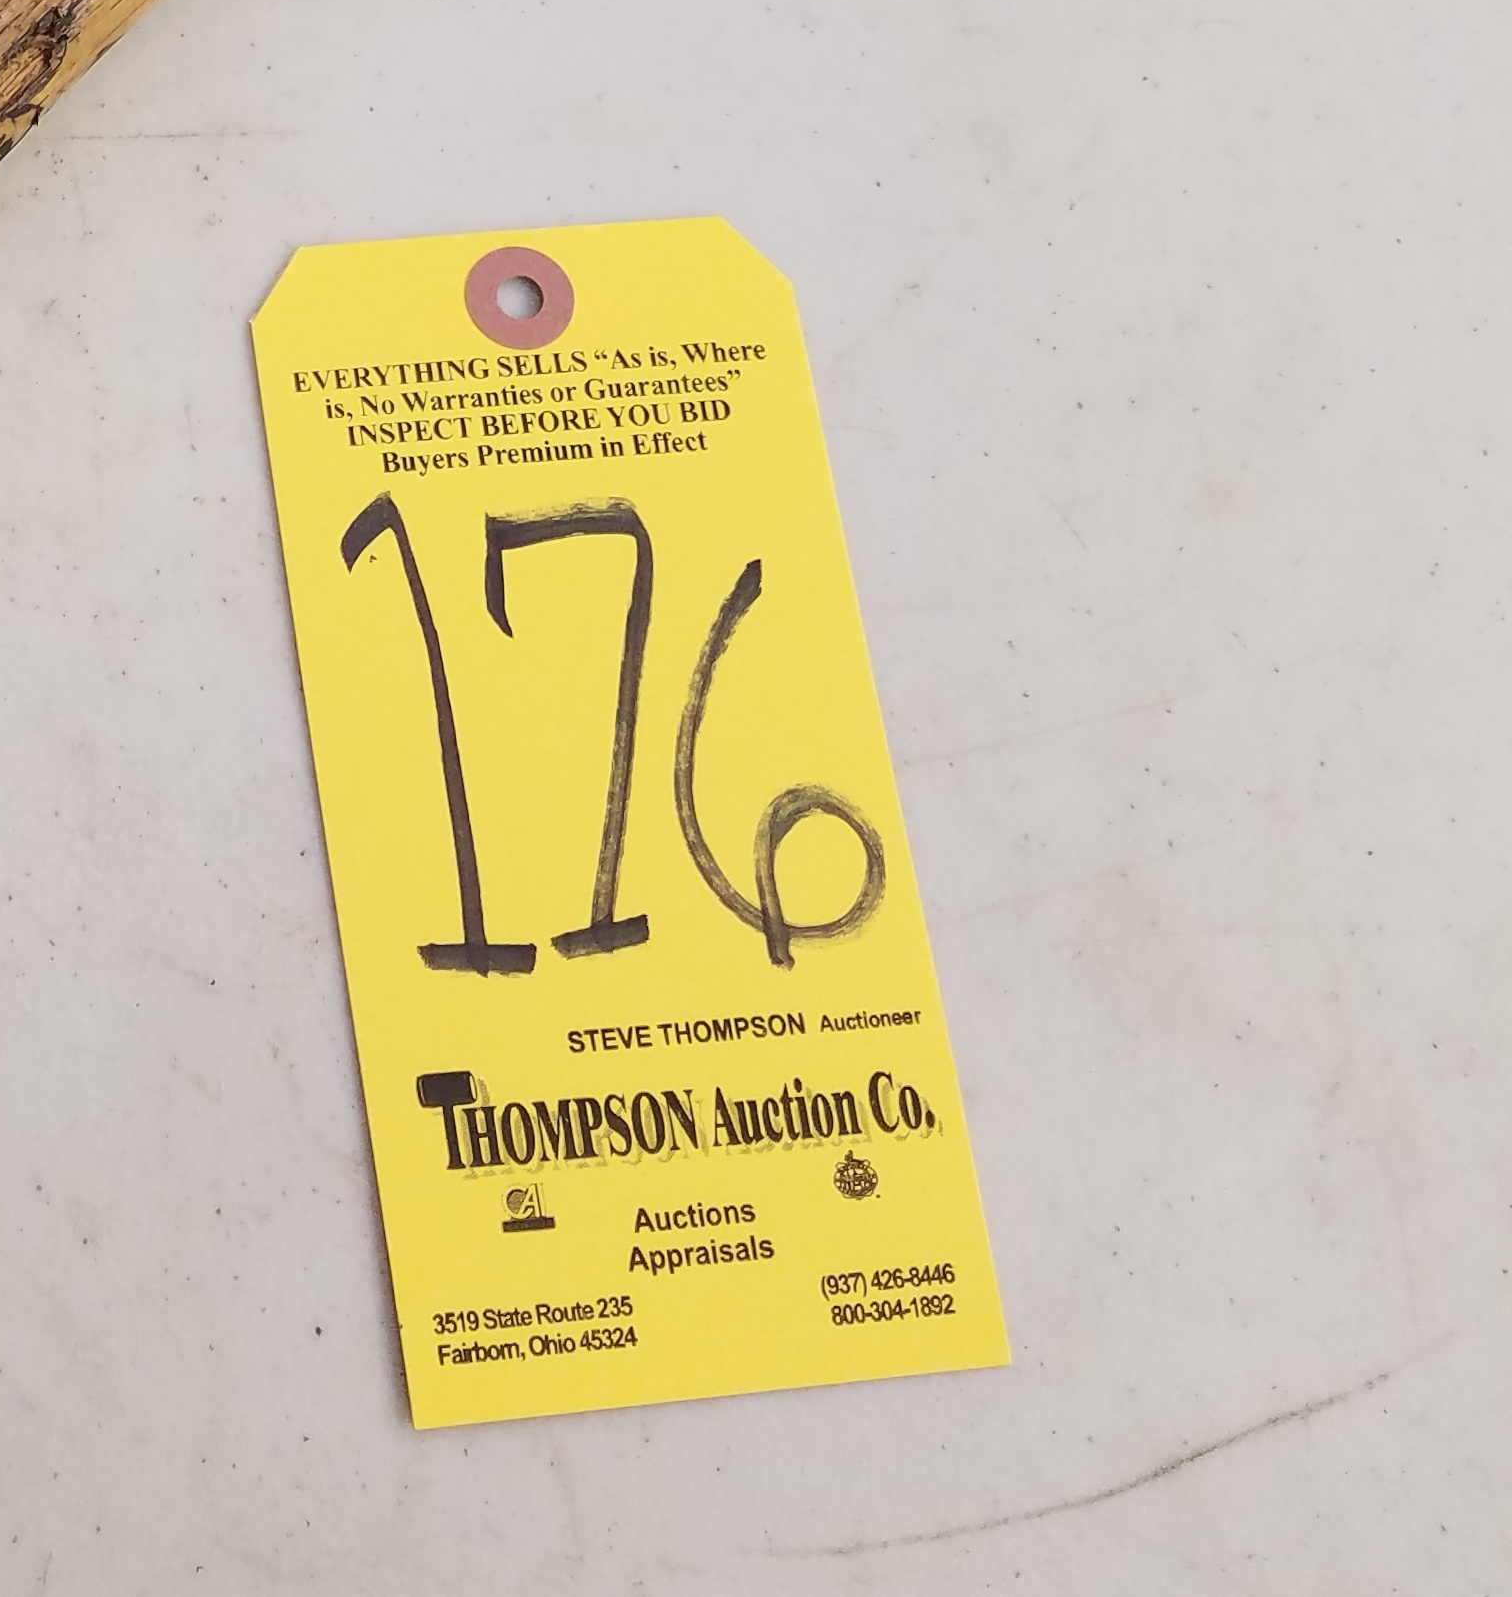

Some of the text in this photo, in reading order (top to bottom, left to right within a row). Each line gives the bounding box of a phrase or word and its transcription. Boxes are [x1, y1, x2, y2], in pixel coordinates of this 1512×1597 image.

[293, 342, 765, 393] EVERYTHING SELLS “As is, Where
[325, 369, 741, 420] is, No Warranties or Guarantees”
[347, 399, 731, 447] INSPECT BEFORE YOU BID
[381, 431, 707, 477] Buyers Premium in Effect
[340, 490, 886, 974] 176
[567, 1010, 922, 1054] STEVE THOMPSON Auctioneer
[416, 1070, 936, 1171] THOMPSON Auction Co.
[634, 1204, 756, 1234] Auctions
[628, 1236, 775, 1277] Appraisals
[821, 1262, 956, 1301] (937) 426-8446
[432, 1295, 634, 1335] 3519 State Route 235
[830, 1293, 956, 1327] 800-304-1892
[528, 1332, 577, 1357] Ohio
[579, 1325, 639, 1352] 45324
